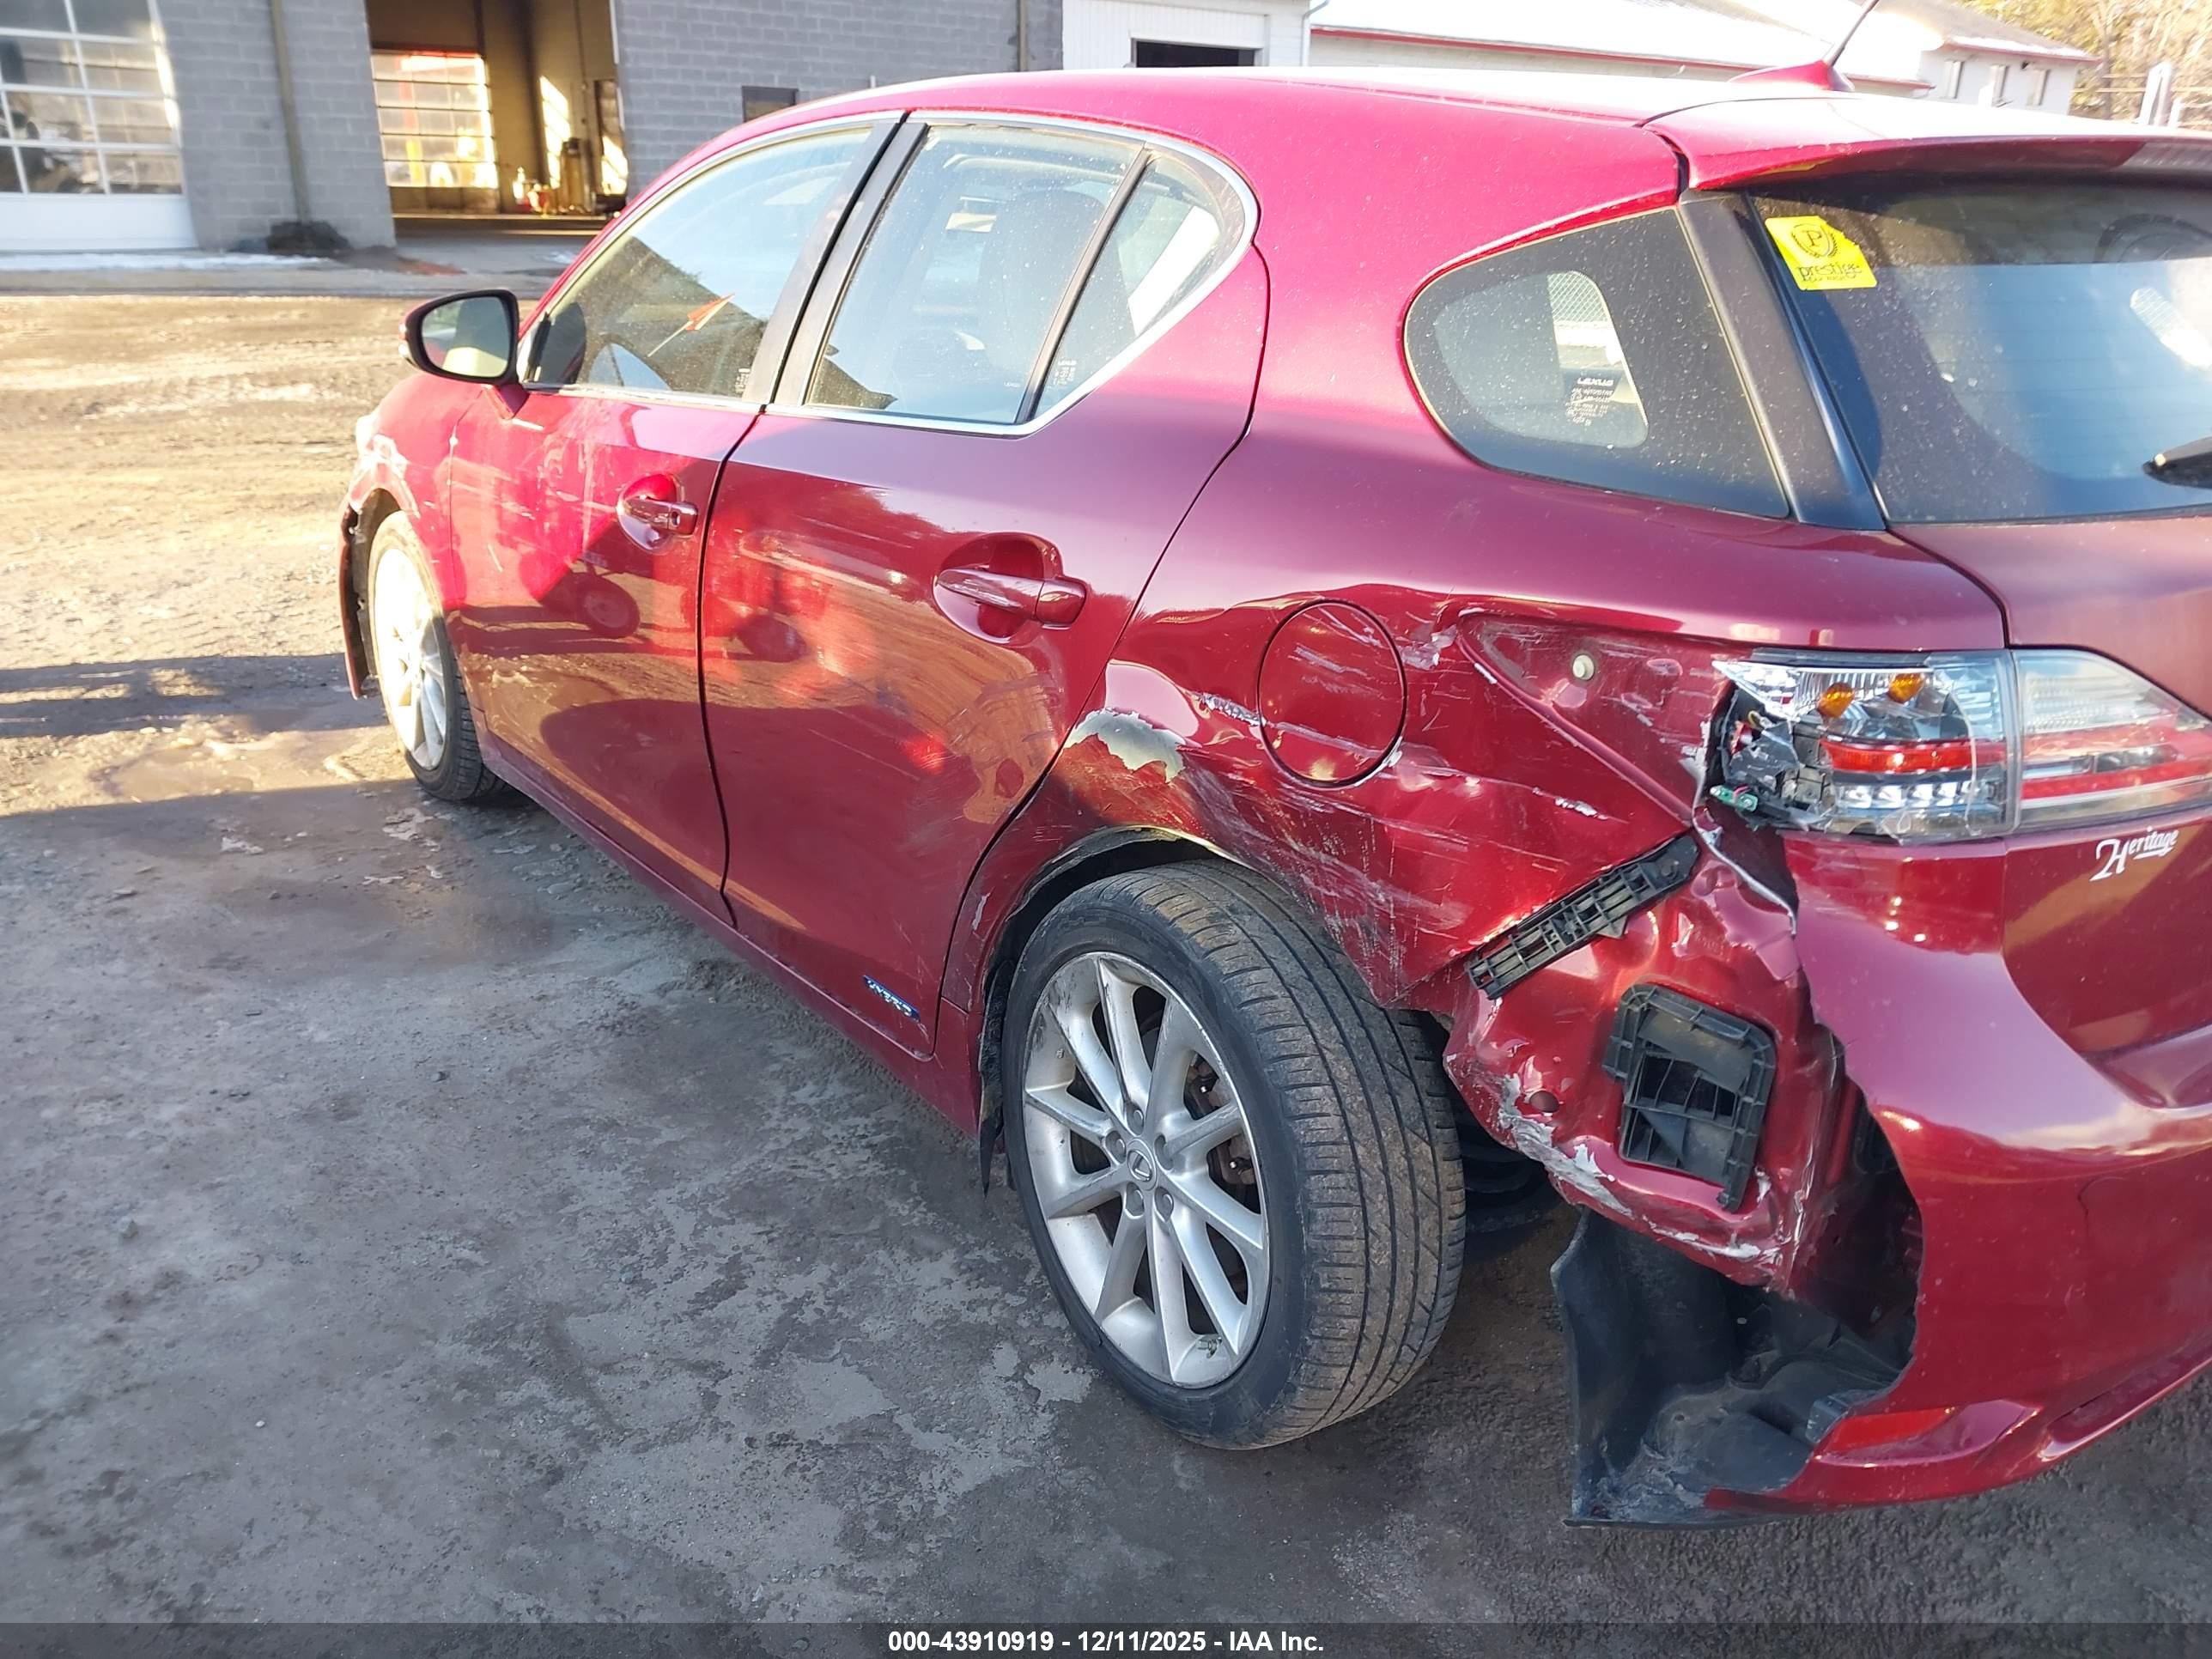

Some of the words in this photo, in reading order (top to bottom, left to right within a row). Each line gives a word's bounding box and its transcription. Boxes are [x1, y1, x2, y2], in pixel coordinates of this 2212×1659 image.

[1802, 229, 1823, 247] P
[1797, 262, 1863, 282] prestige
[1577, 377, 1614, 386] LEXUS
[2089, 826, 2179, 882] Heritage
